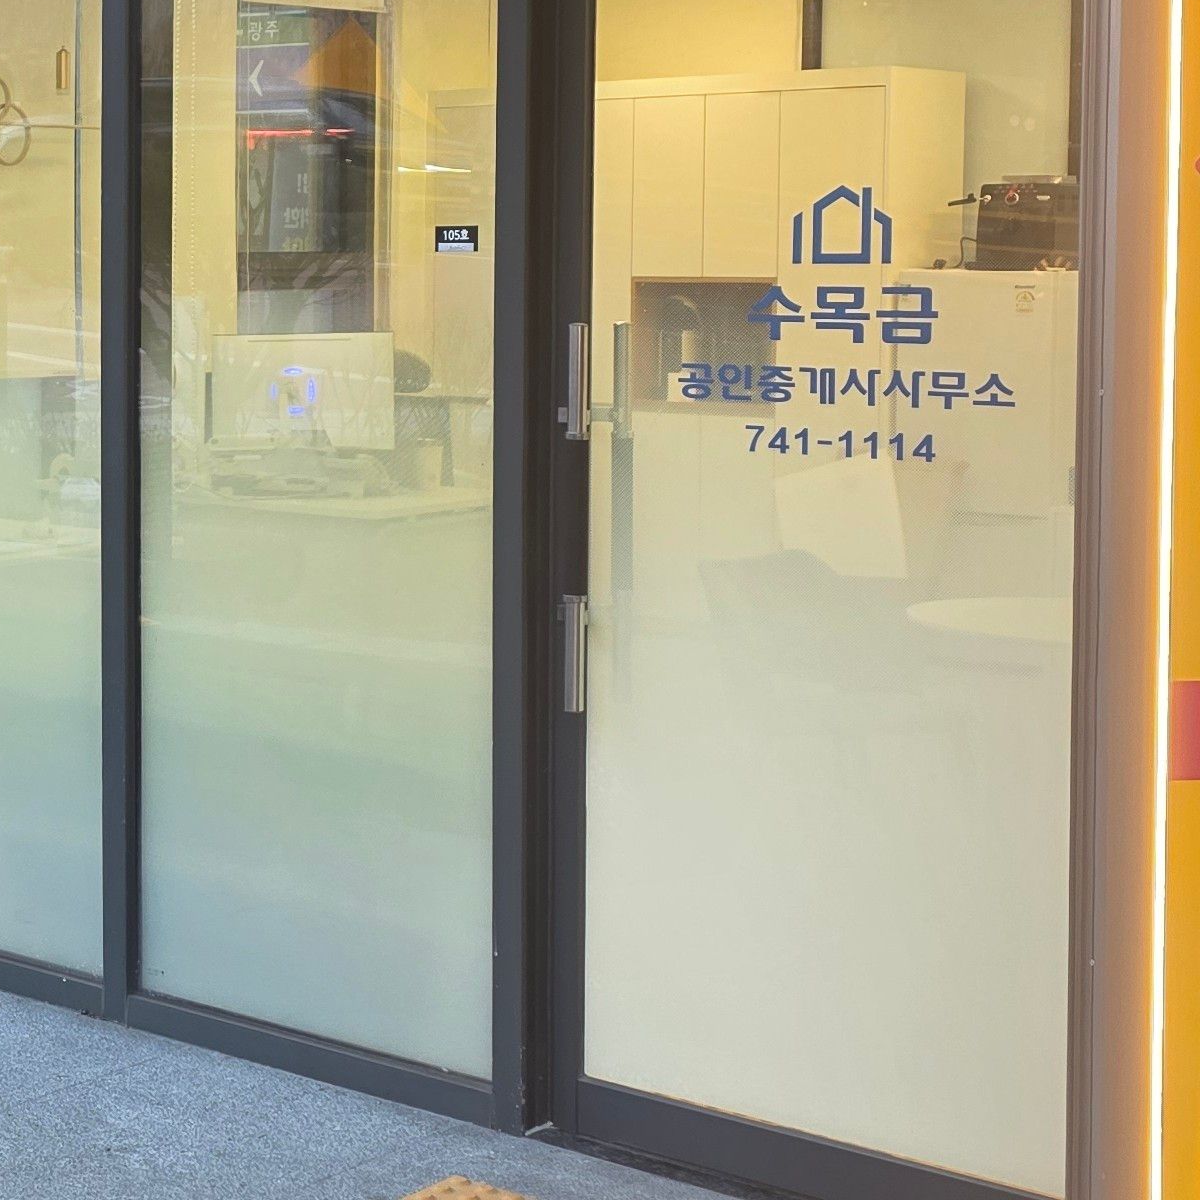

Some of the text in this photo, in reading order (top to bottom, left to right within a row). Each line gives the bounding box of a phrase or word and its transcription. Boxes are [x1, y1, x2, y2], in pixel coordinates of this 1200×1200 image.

[443, 229, 470, 241] 105호
[746, 285, 939, 345] 수목금
[677, 362, 1017, 410] 공인중개사사무소
[745, 424, 937, 463] 741-1114
